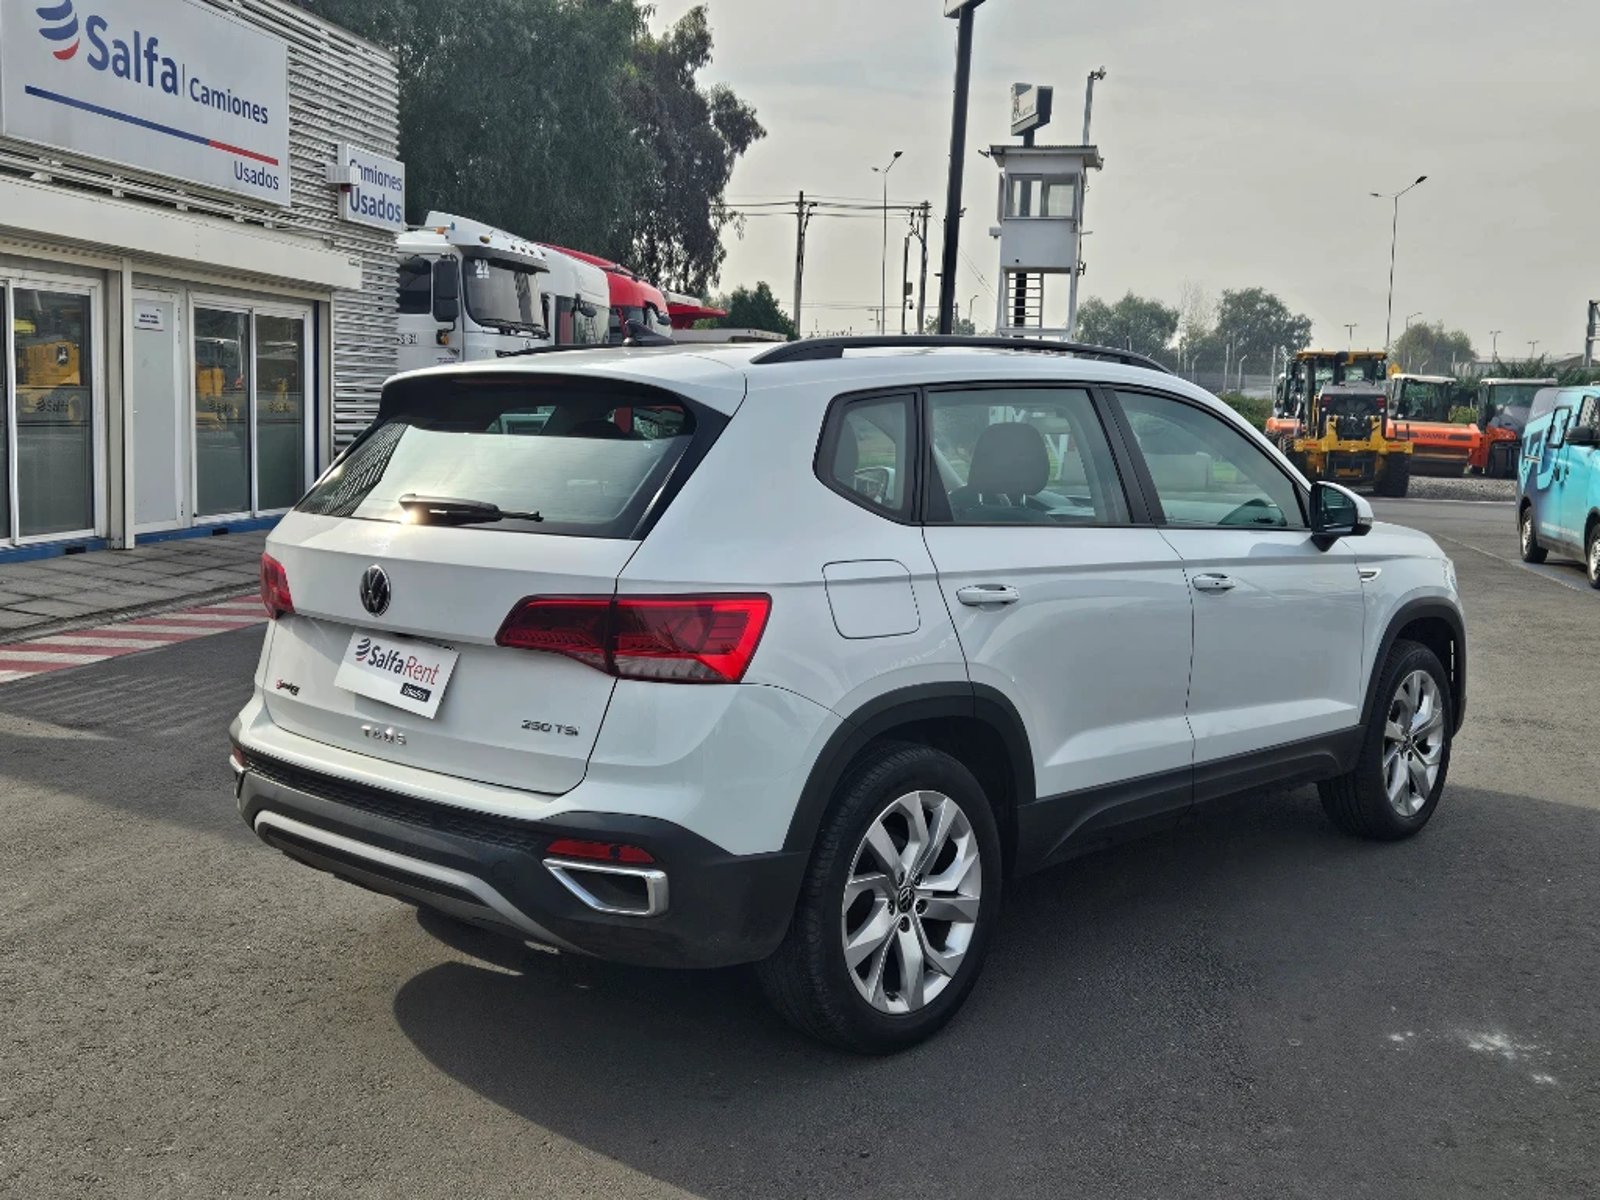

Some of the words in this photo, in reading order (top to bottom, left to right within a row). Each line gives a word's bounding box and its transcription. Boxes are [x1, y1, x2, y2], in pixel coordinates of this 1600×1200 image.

[86, 14, 178, 96] Salfa
[190, 77, 269, 125] Camiones
[233, 160, 280, 191] Usados
[350, 187, 402, 223] Usados
[367, 645, 440, 686] SalfaRent
